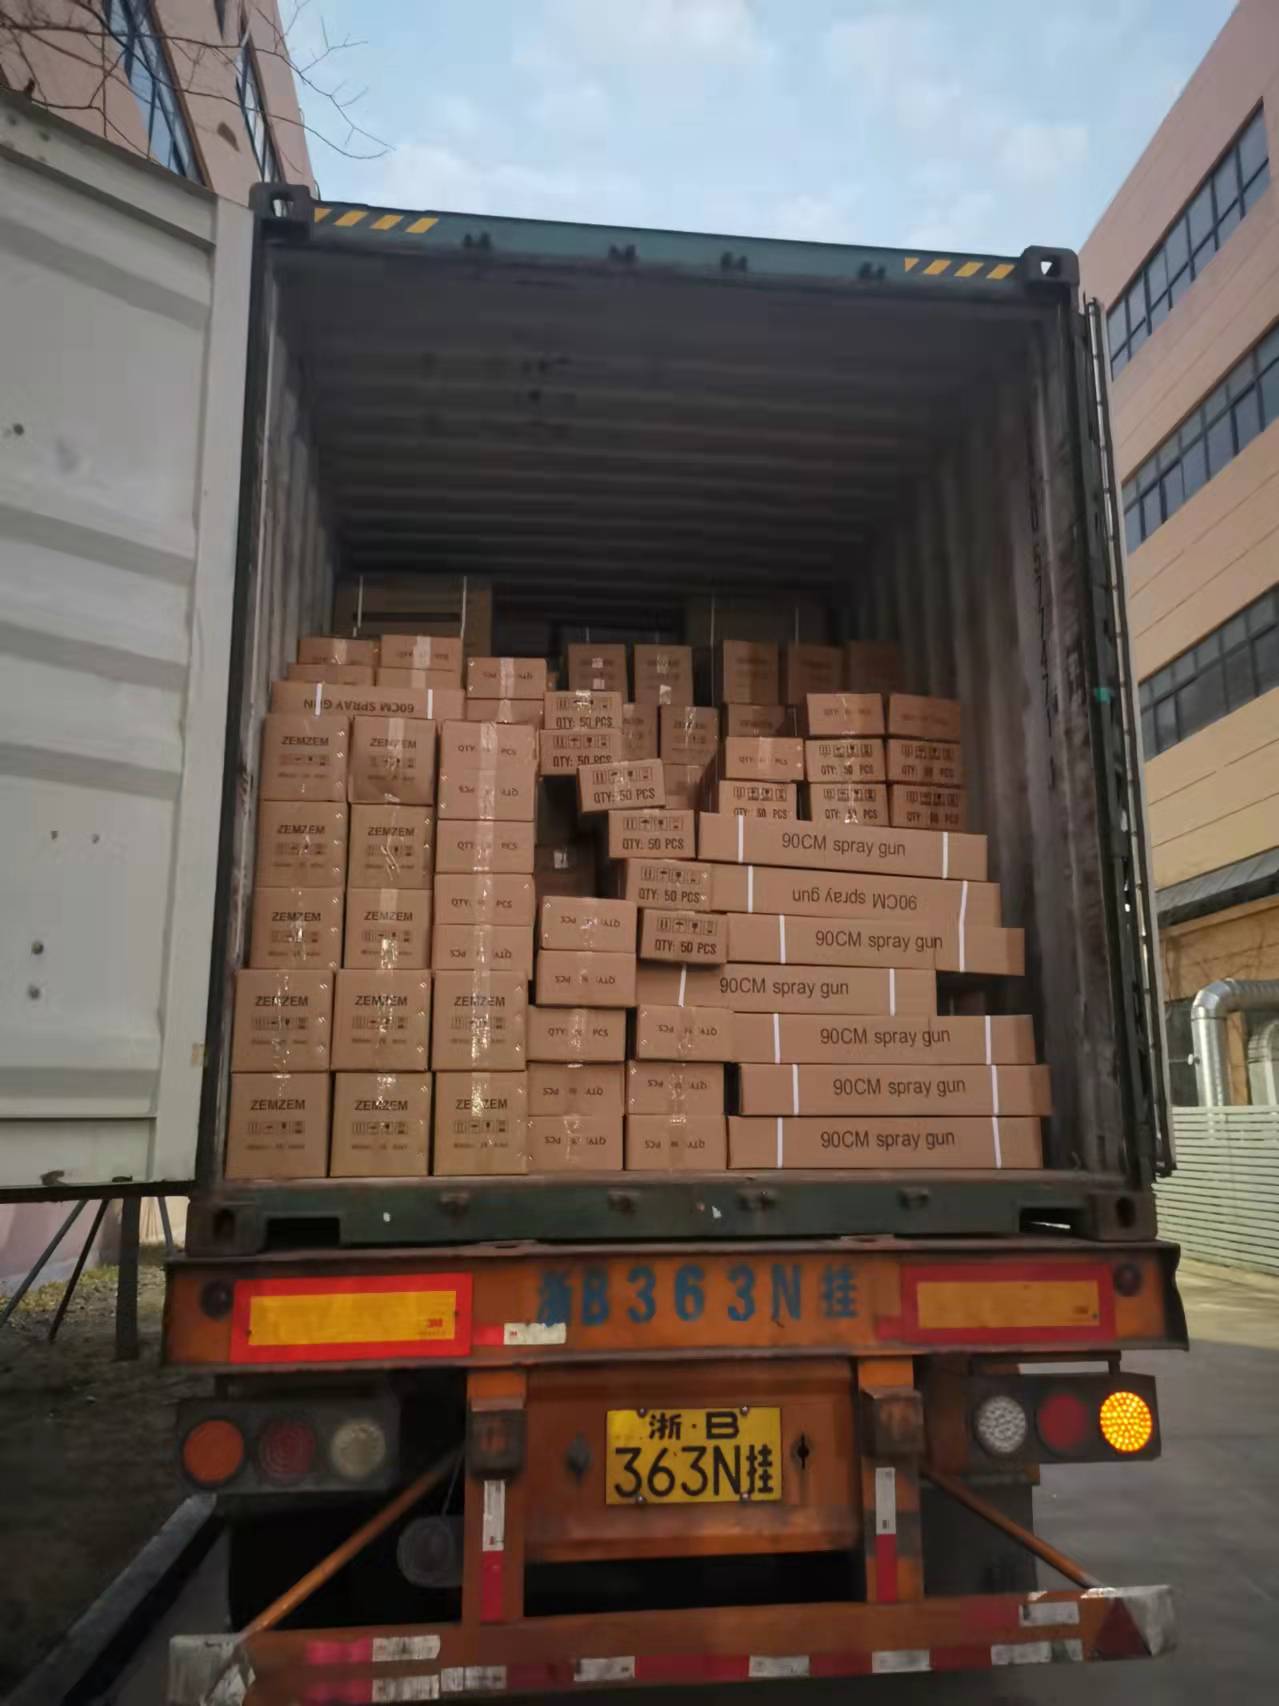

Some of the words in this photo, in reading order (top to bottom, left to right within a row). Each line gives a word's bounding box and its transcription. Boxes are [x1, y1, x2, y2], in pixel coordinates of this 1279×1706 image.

[303, 699, 333, 710] GN
[335, 700, 376, 712] SPRAY
[380, 703, 415, 713] 60CM
[579, 716, 592, 729] 50
[595, 716, 613, 728] PCS
[281, 736, 329, 746] ZEMZEM
[578, 754, 590, 765] 50
[619, 789, 632, 801] 50
[636, 787, 656, 800] PCS
[772, 808, 788, 820] PCS
[863, 808, 879, 820] PCS
[277, 824, 325, 835] ZEMZEM
[367, 826, 415, 837] ZEMZEM
[647, 838, 661, 850] 50
[665, 838, 684, 850] PCS
[781, 832, 826, 851] 90CM
[833, 837, 874, 857] spray
[878, 841, 906, 857] gun
[664, 889, 677, 902] 50
[681, 891, 701, 904] PCS
[792, 887, 820, 902] gun
[824, 886, 866, 906] spray
[872, 893, 918, 911] 90CM
[271, 911, 322, 922] ZEMZEM
[363, 911, 413, 922] ZEMZEM
[815, 930, 862, 947] 90CM
[867, 933, 910, 953] spray
[915, 933, 943, 951] gun
[680, 941, 694, 953] 50
[696, 941, 718, 955] PCS
[719, 976, 766, 994] 90CM
[772, 979, 816, 998] spray
[820, 981, 849, 998] gun
[255, 995, 309, 1007] ZEMZEM
[354, 995, 408, 1007] ZEMZEM
[454, 995, 506, 1007] ZEMZEM
[819, 1027, 868, 1045] 90CM
[873, 1029, 917, 1049] spray
[922, 1028, 950, 1047] gun
[832, 1078, 881, 1096] 90CM
[887, 1079, 931, 1099] spray
[936, 1078, 966, 1098] gun
[250, 1099, 306, 1111] ZEMZEM
[354, 1099, 409, 1111] ZEMZEM
[455, 1098, 508, 1110] ZEZEM
[820, 1130, 870, 1148] 90CM
[876, 1131, 921, 1151] spray
[926, 1130, 955, 1150] gun
[614, 1444, 775, 1498] 363N挂
